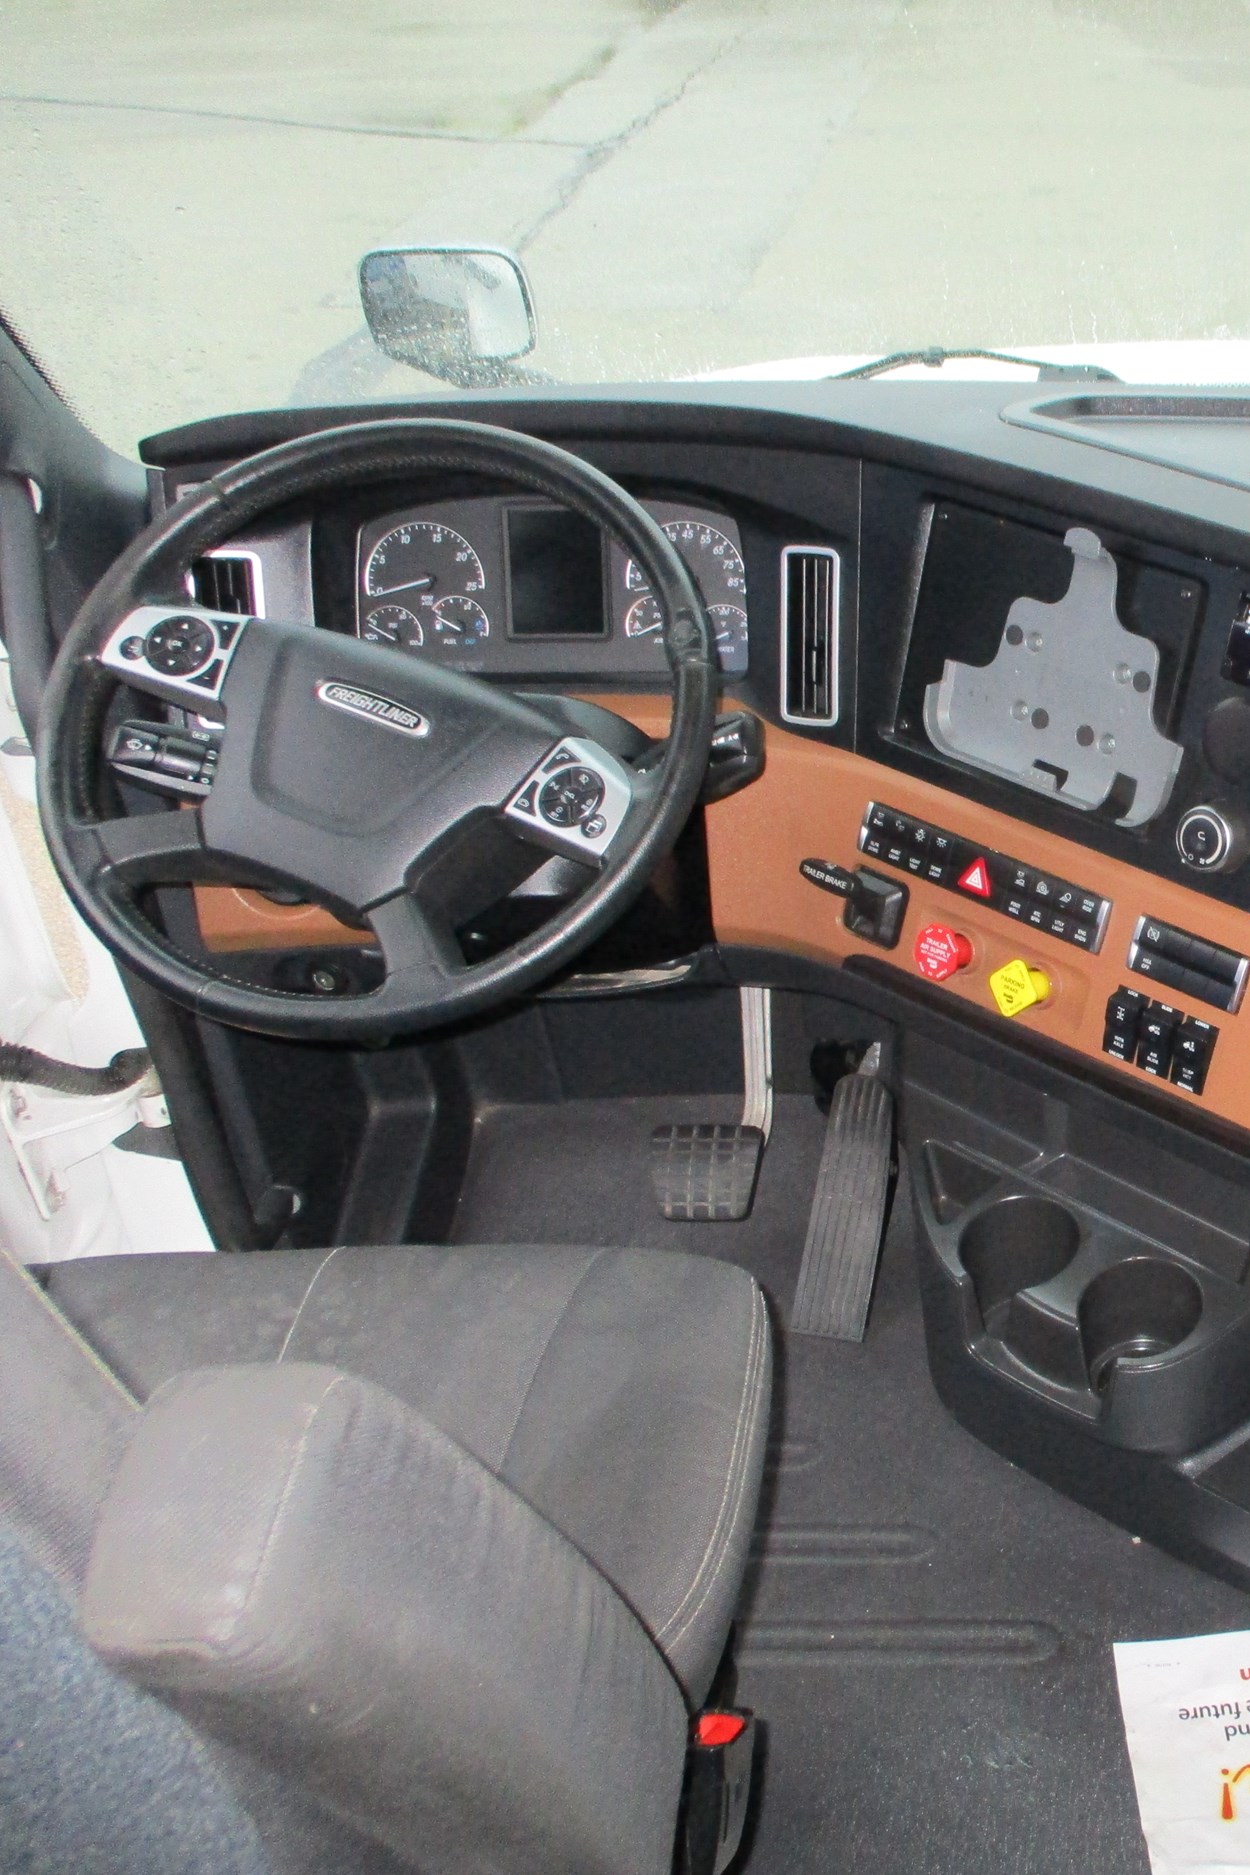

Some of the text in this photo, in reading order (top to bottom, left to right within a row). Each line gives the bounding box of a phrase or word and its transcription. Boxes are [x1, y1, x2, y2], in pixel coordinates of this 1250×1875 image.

[401, 534, 411, 545] 10
[432, 533, 443, 544] 15
[681, 529, 694, 540] 45
[700, 535, 712, 544] 55
[712, 545, 725, 555] 65
[455, 552, 468, 562] 20
[722, 560, 735, 570] 75
[465, 582, 478, 591] 25
[727, 578, 739, 587] 85
[328, 686, 419, 728] FREIGHTLINER
[802, 864, 848, 890] TRAILER BRAKE
[926, 937, 949, 951] TRAILER
[929, 945, 951, 959] SUPPLY
[1000, 975, 1025, 990] PARKING
[1178, 1701, 1242, 1721] future
